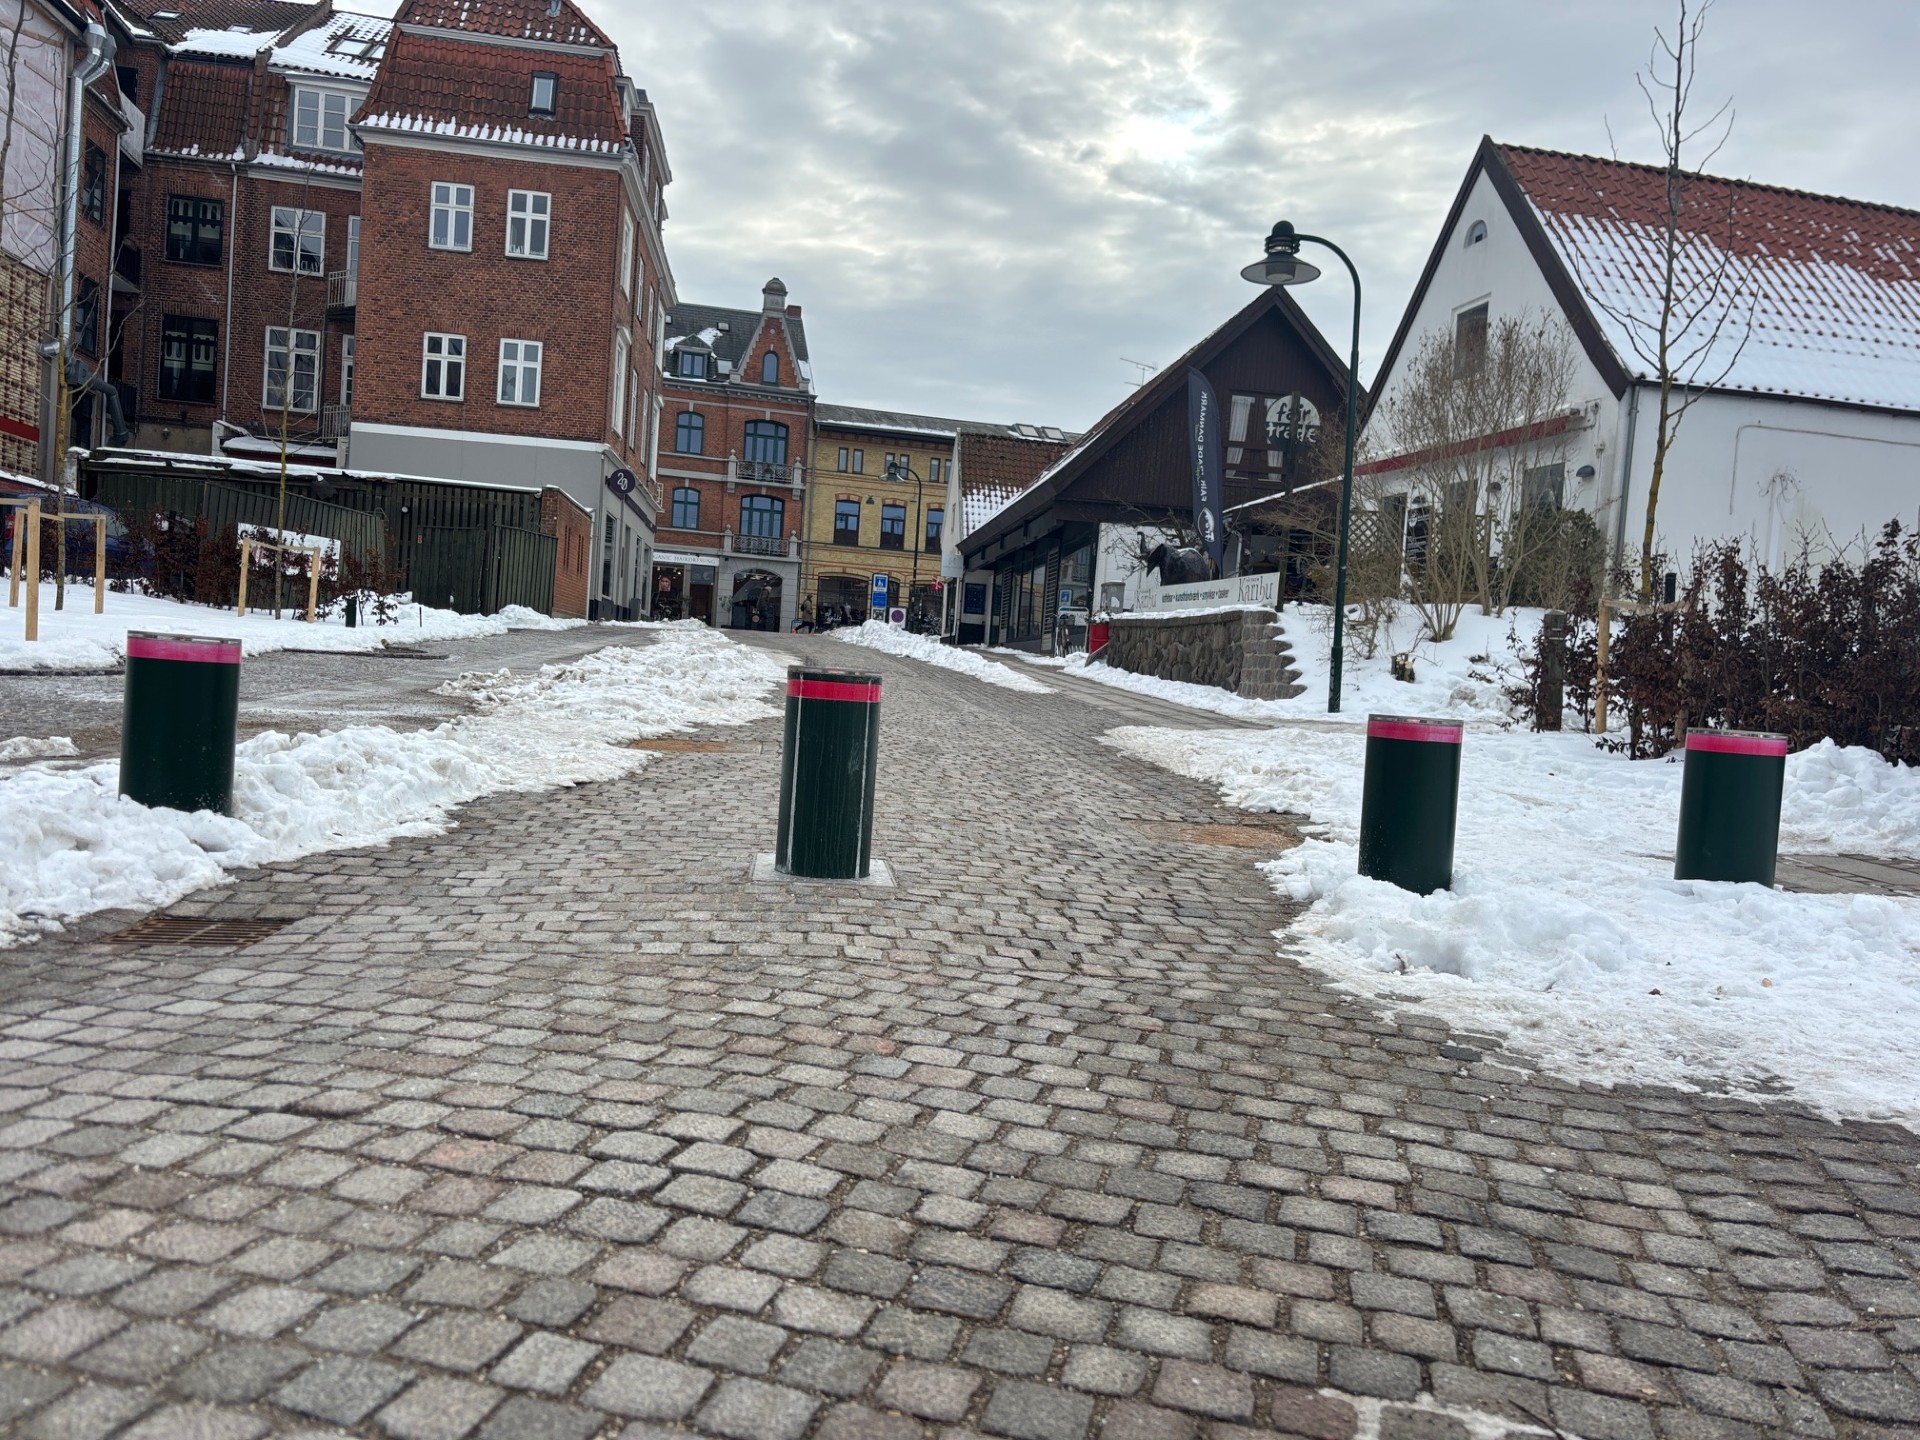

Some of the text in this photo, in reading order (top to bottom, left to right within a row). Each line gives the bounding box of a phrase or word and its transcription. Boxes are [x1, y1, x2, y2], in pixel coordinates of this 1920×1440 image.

[300, 260, 319, 272] CLAY
[617, 472, 628, 490] 20
[1237, 575, 1273, 604] Karibu
